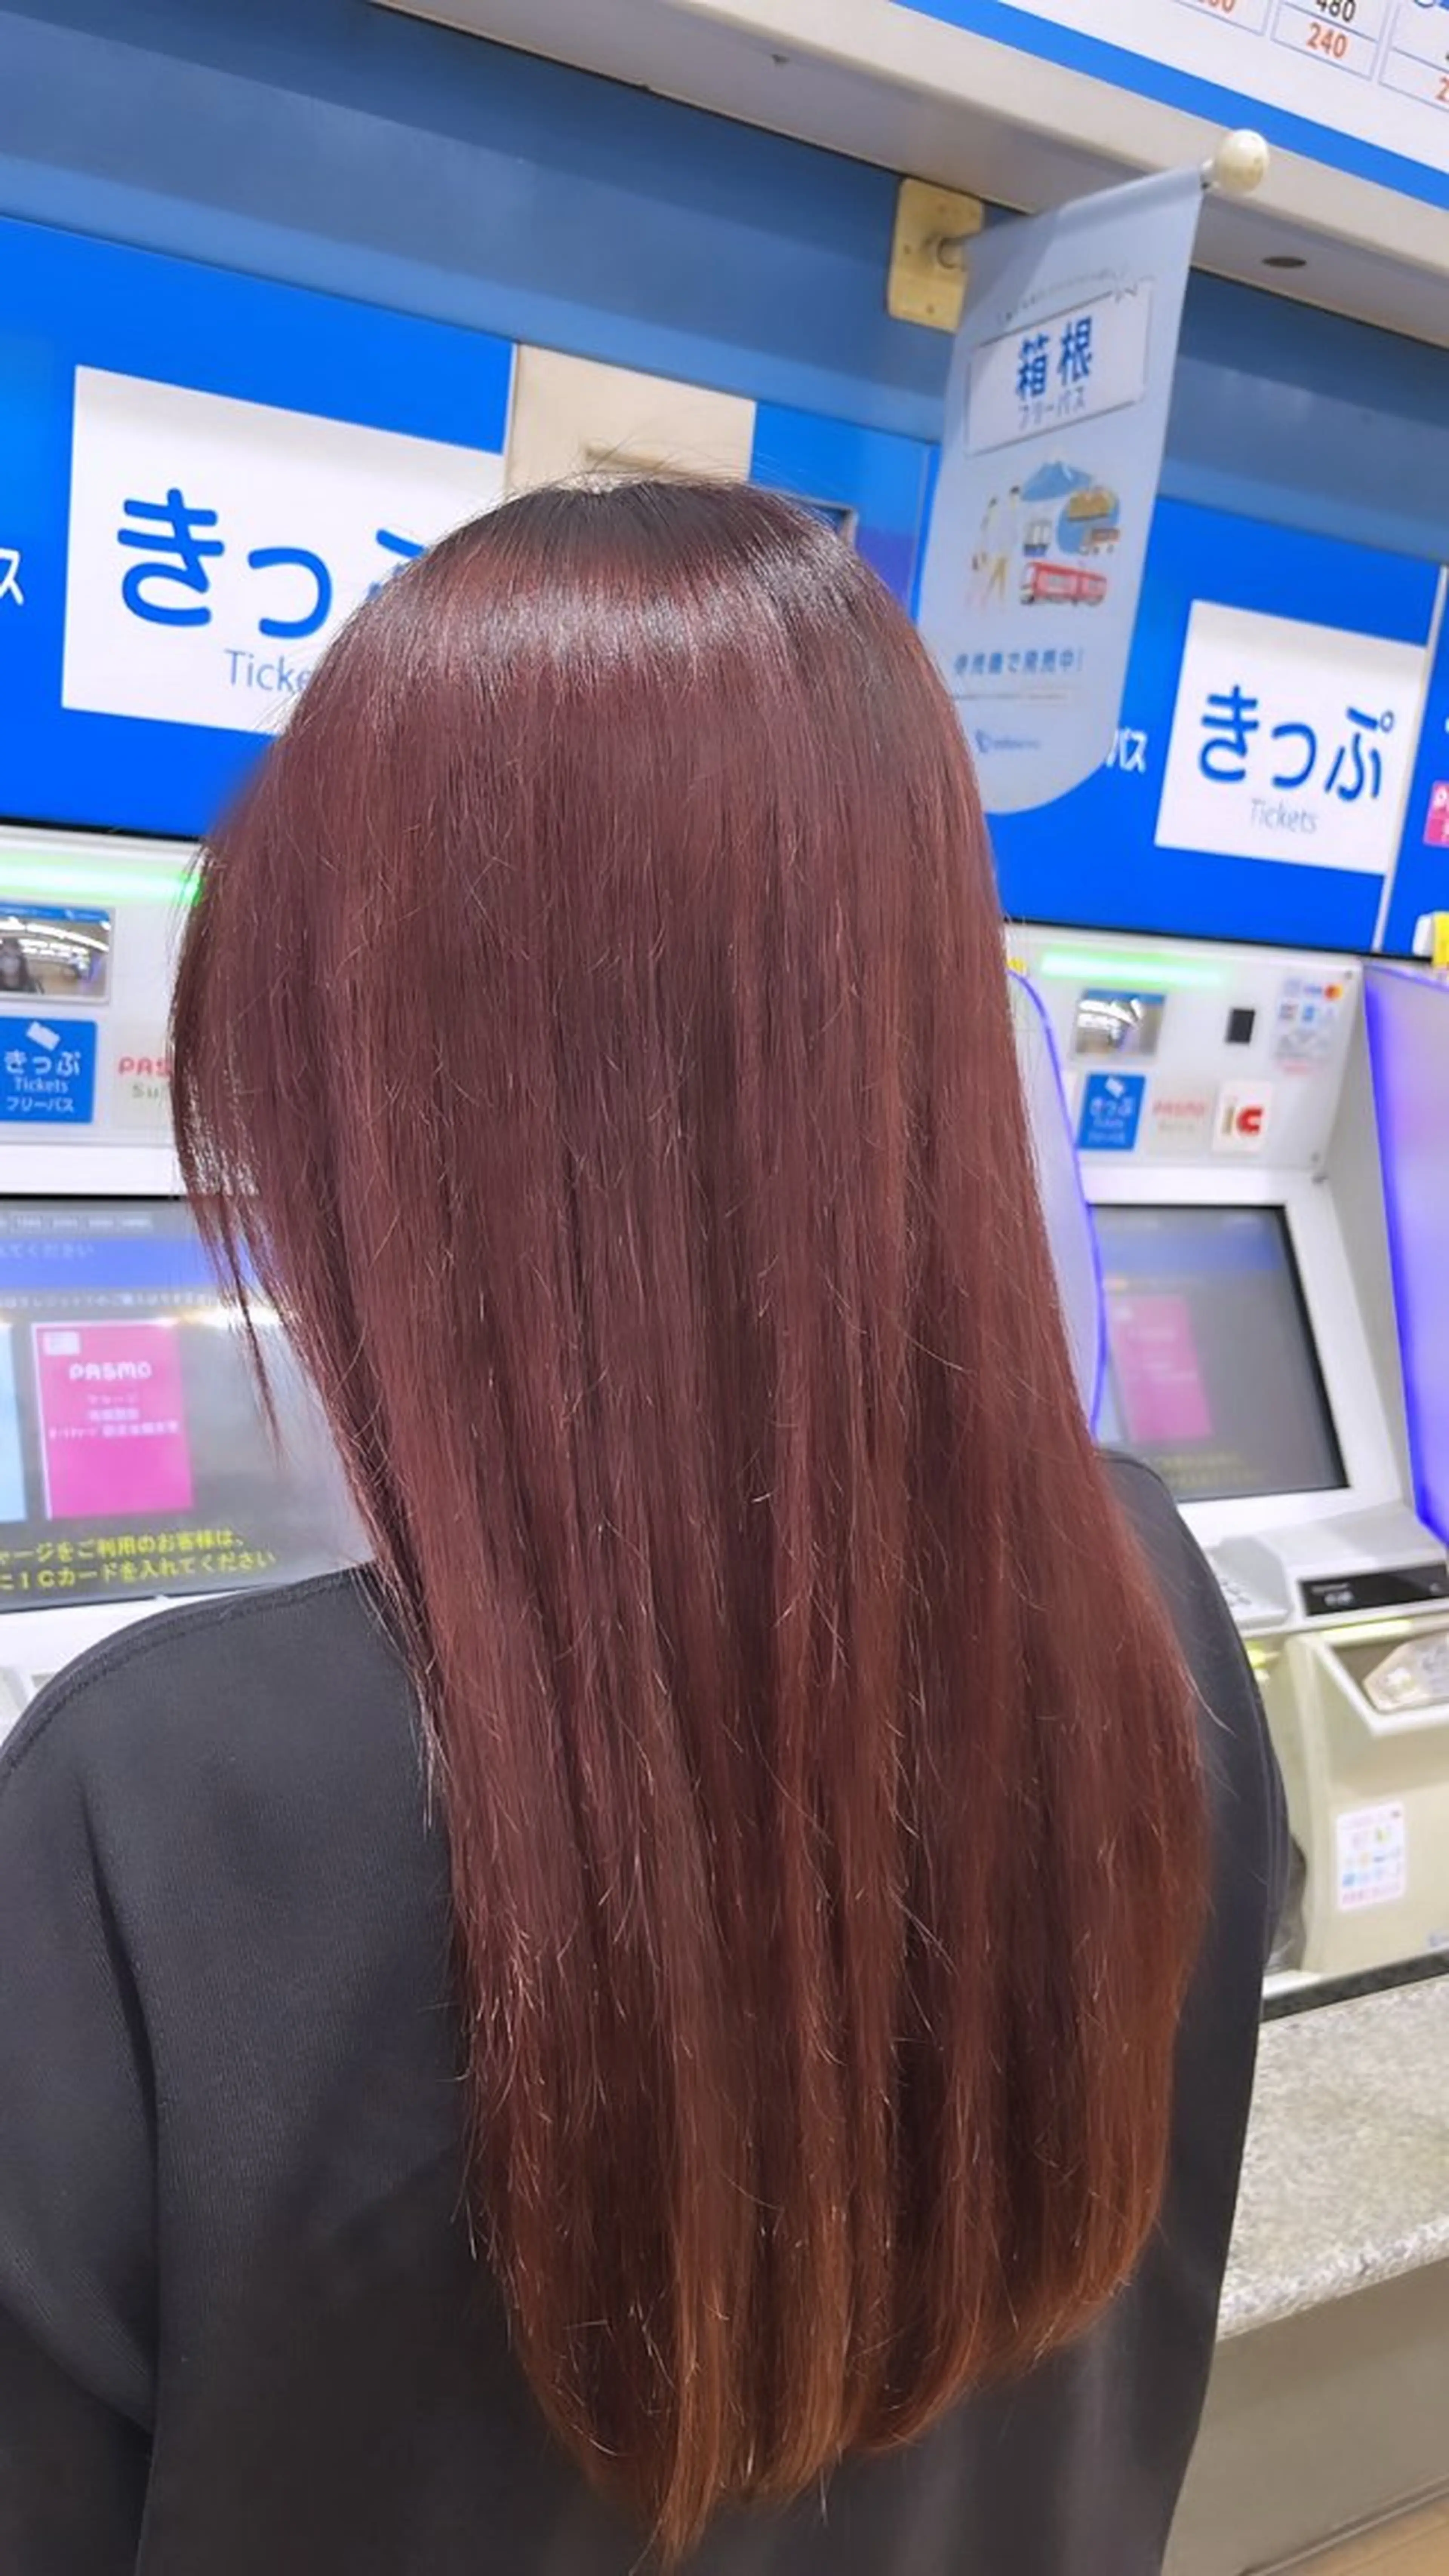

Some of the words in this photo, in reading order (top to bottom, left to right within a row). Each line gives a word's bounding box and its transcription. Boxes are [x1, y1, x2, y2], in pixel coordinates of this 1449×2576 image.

[1306, 22, 1348, 58] 240
[1016, 316, 1092, 401] 箱根
[117, 488, 429, 638] きっ
[1198, 685, 1395, 801] きっぷ
[1251, 797, 1318, 835] Tickets
[3, 1050, 82, 1077] きっぷ
[14, 1076, 69, 1093] Tickets
[6, 1096, 74, 1113] フリーパス
[69, 1361, 153, 1381] PASMO
